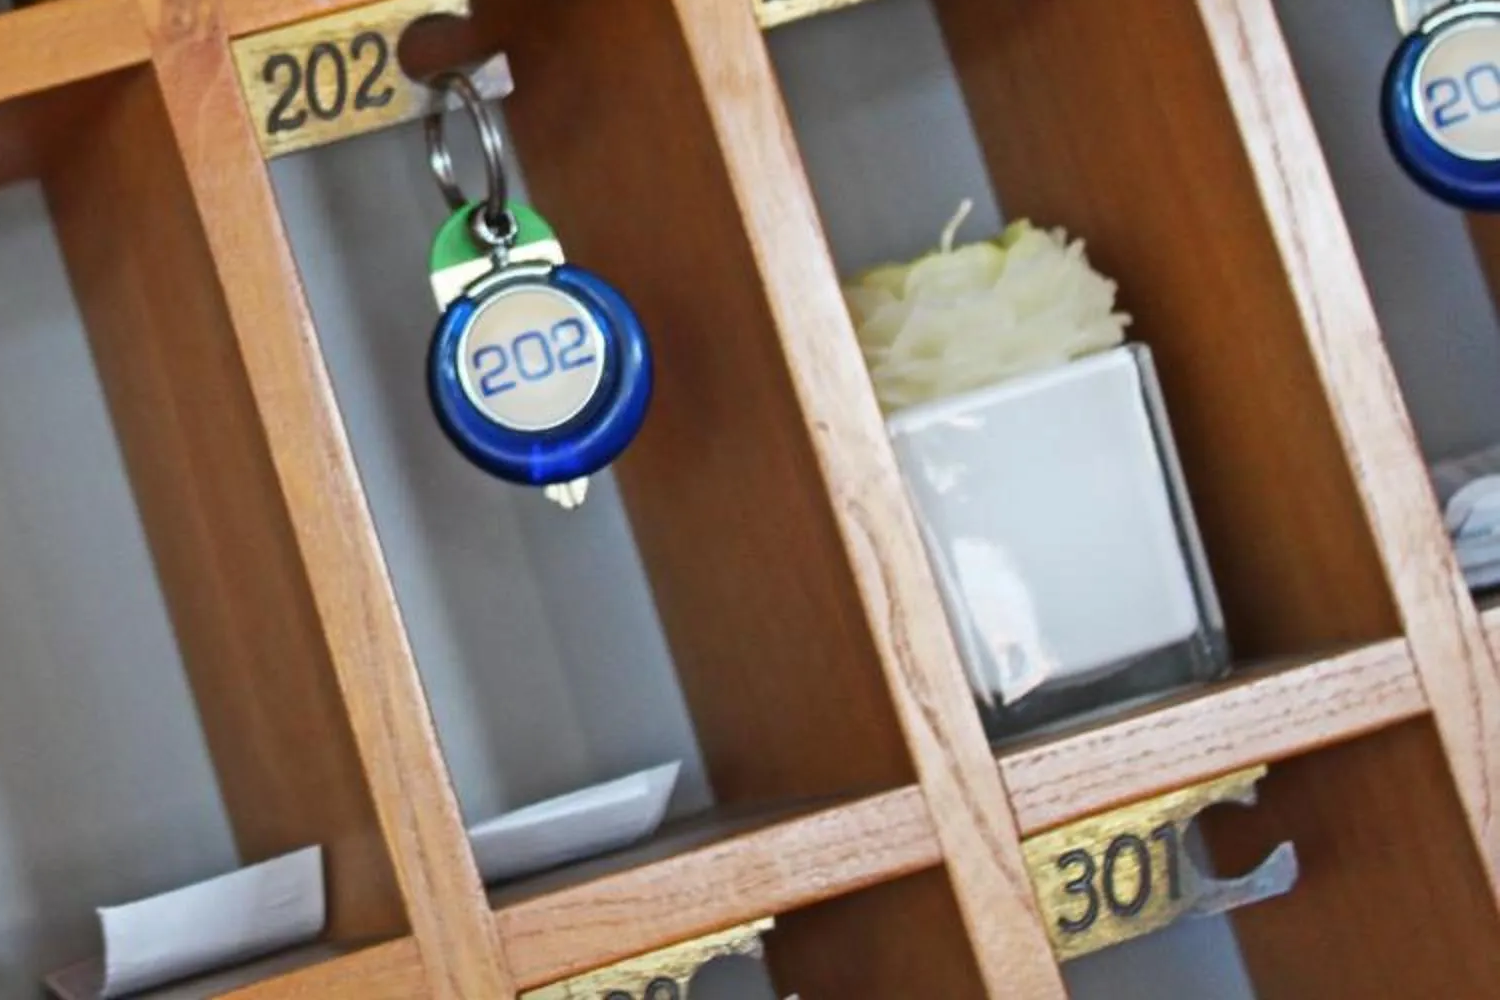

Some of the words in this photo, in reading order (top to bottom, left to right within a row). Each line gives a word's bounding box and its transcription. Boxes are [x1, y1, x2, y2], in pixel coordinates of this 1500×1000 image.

[261, 30, 395, 136] 202
[1425, 62, 1500, 130] 20
[471, 316, 596, 398] 202
[1056, 820, 1181, 934] 301
